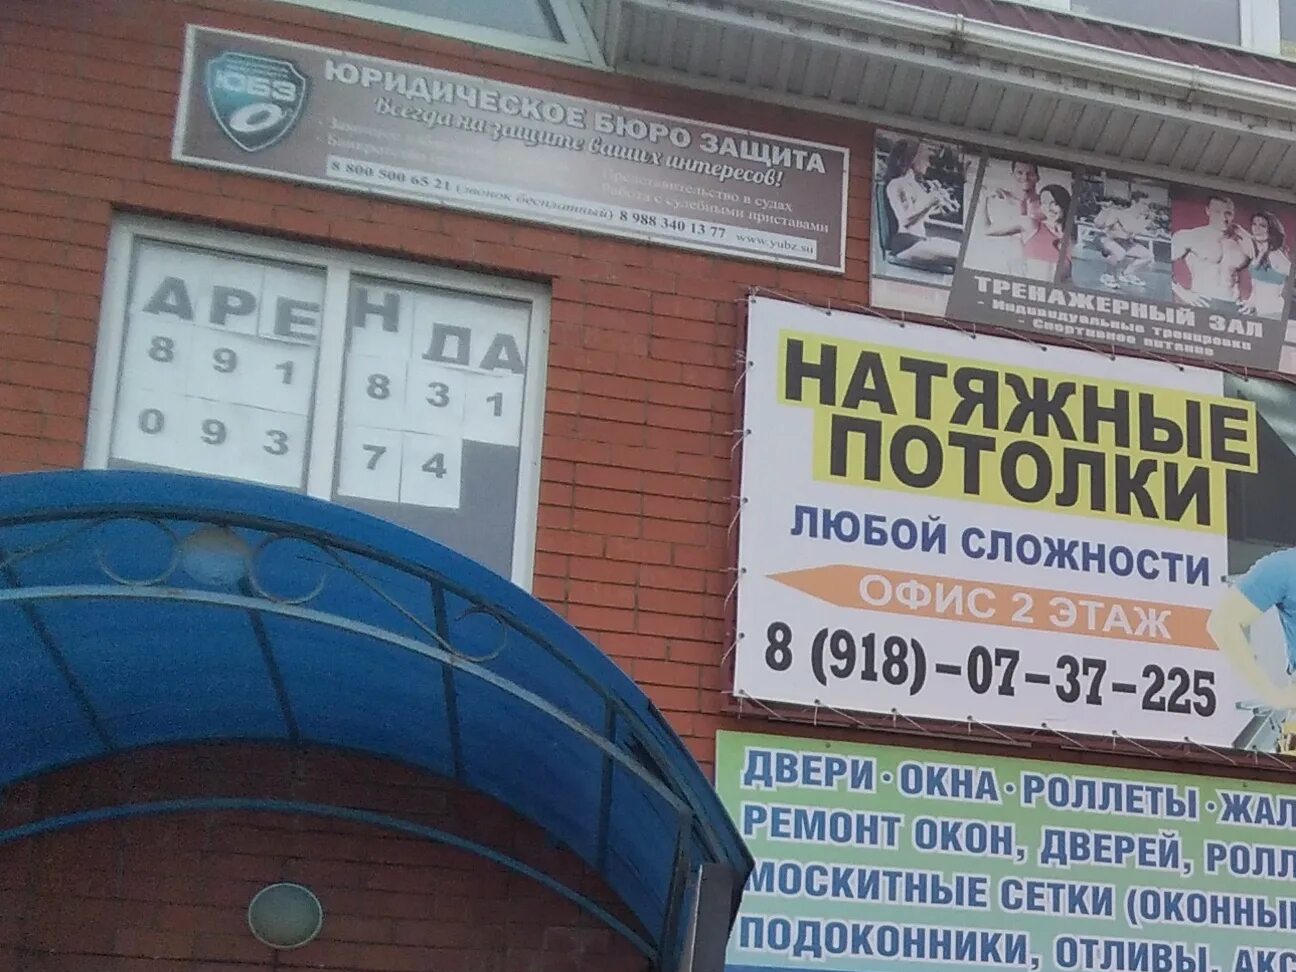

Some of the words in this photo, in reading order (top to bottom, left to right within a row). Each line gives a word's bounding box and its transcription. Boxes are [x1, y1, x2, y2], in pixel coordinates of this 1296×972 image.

[214, 70, 296, 102] ЮБЗ
[324, 58, 586, 129] ЮРИДИЧЕСКОЕ
[595, 112, 692, 148] БЮРО
[700, 132, 826, 174] ЗАЩИТА
[375, 97, 453, 129] Всегда
[456, 111, 486, 131] на
[491, 120, 584, 151] защите
[588, 136, 662, 165] ваших
[665, 153, 784, 188] интересов!
[331, 161, 341, 172] 8
[346, 163, 374, 177] 800
[378, 167, 406, 183] 500
[411, 174, 429, 188] 65
[433, 177, 450, 192] 21
[620, 210, 628, 221] 8
[632, 212, 656, 228] 988
[659, 216, 686, 232] 340
[691, 222, 707, 235] 13
[710, 226, 726, 239] 77
[664, 195, 745, 219] судебными
[748, 210, 829, 234] приставами
[754, 195, 793, 213] судах
[974, 275, 1196, 327] ТРЕНАЖЕРНЫЙ
[1209, 315, 1263, 338] ЗАЛ
[992, 299, 1145, 333] Индивидуальные
[1152, 326, 1251, 350] тренировки
[1032, 317, 1136, 345] Спортивное
[1144, 337, 1214, 357] питание
[785, 338, 1252, 467] НАТЯЖНЫЕ
[829, 413, 1211, 527] ПОТОЛКИ
[791, 504, 947, 555] ЛЮБОЙ
[961, 526, 1210, 587] СЛОЖНОСТИ
[859, 574, 995, 619] ОФИС
[1011, 592, 1034, 624] 2
[1050, 596, 1172, 639] ЭТАЖ
[765, 621, 793, 671] 8
[743, 749, 873, 791] ДВЕРИ
[900, 762, 999, 801] ОКНА
[1024, 775, 1198, 820] РОЛЛЕТЫ
[744, 804, 901, 848] РЕМОНТ
[914, 817, 1026, 862] ОКОН,
[1040, 829, 1193, 876] ДВЕРЕЙ,
[745, 861, 988, 908] МОСКИТНЫЕ
[1000, 878, 1113, 917] СЕТКИ
[740, 916, 1040, 971] ПОДОКОННИКИ,
